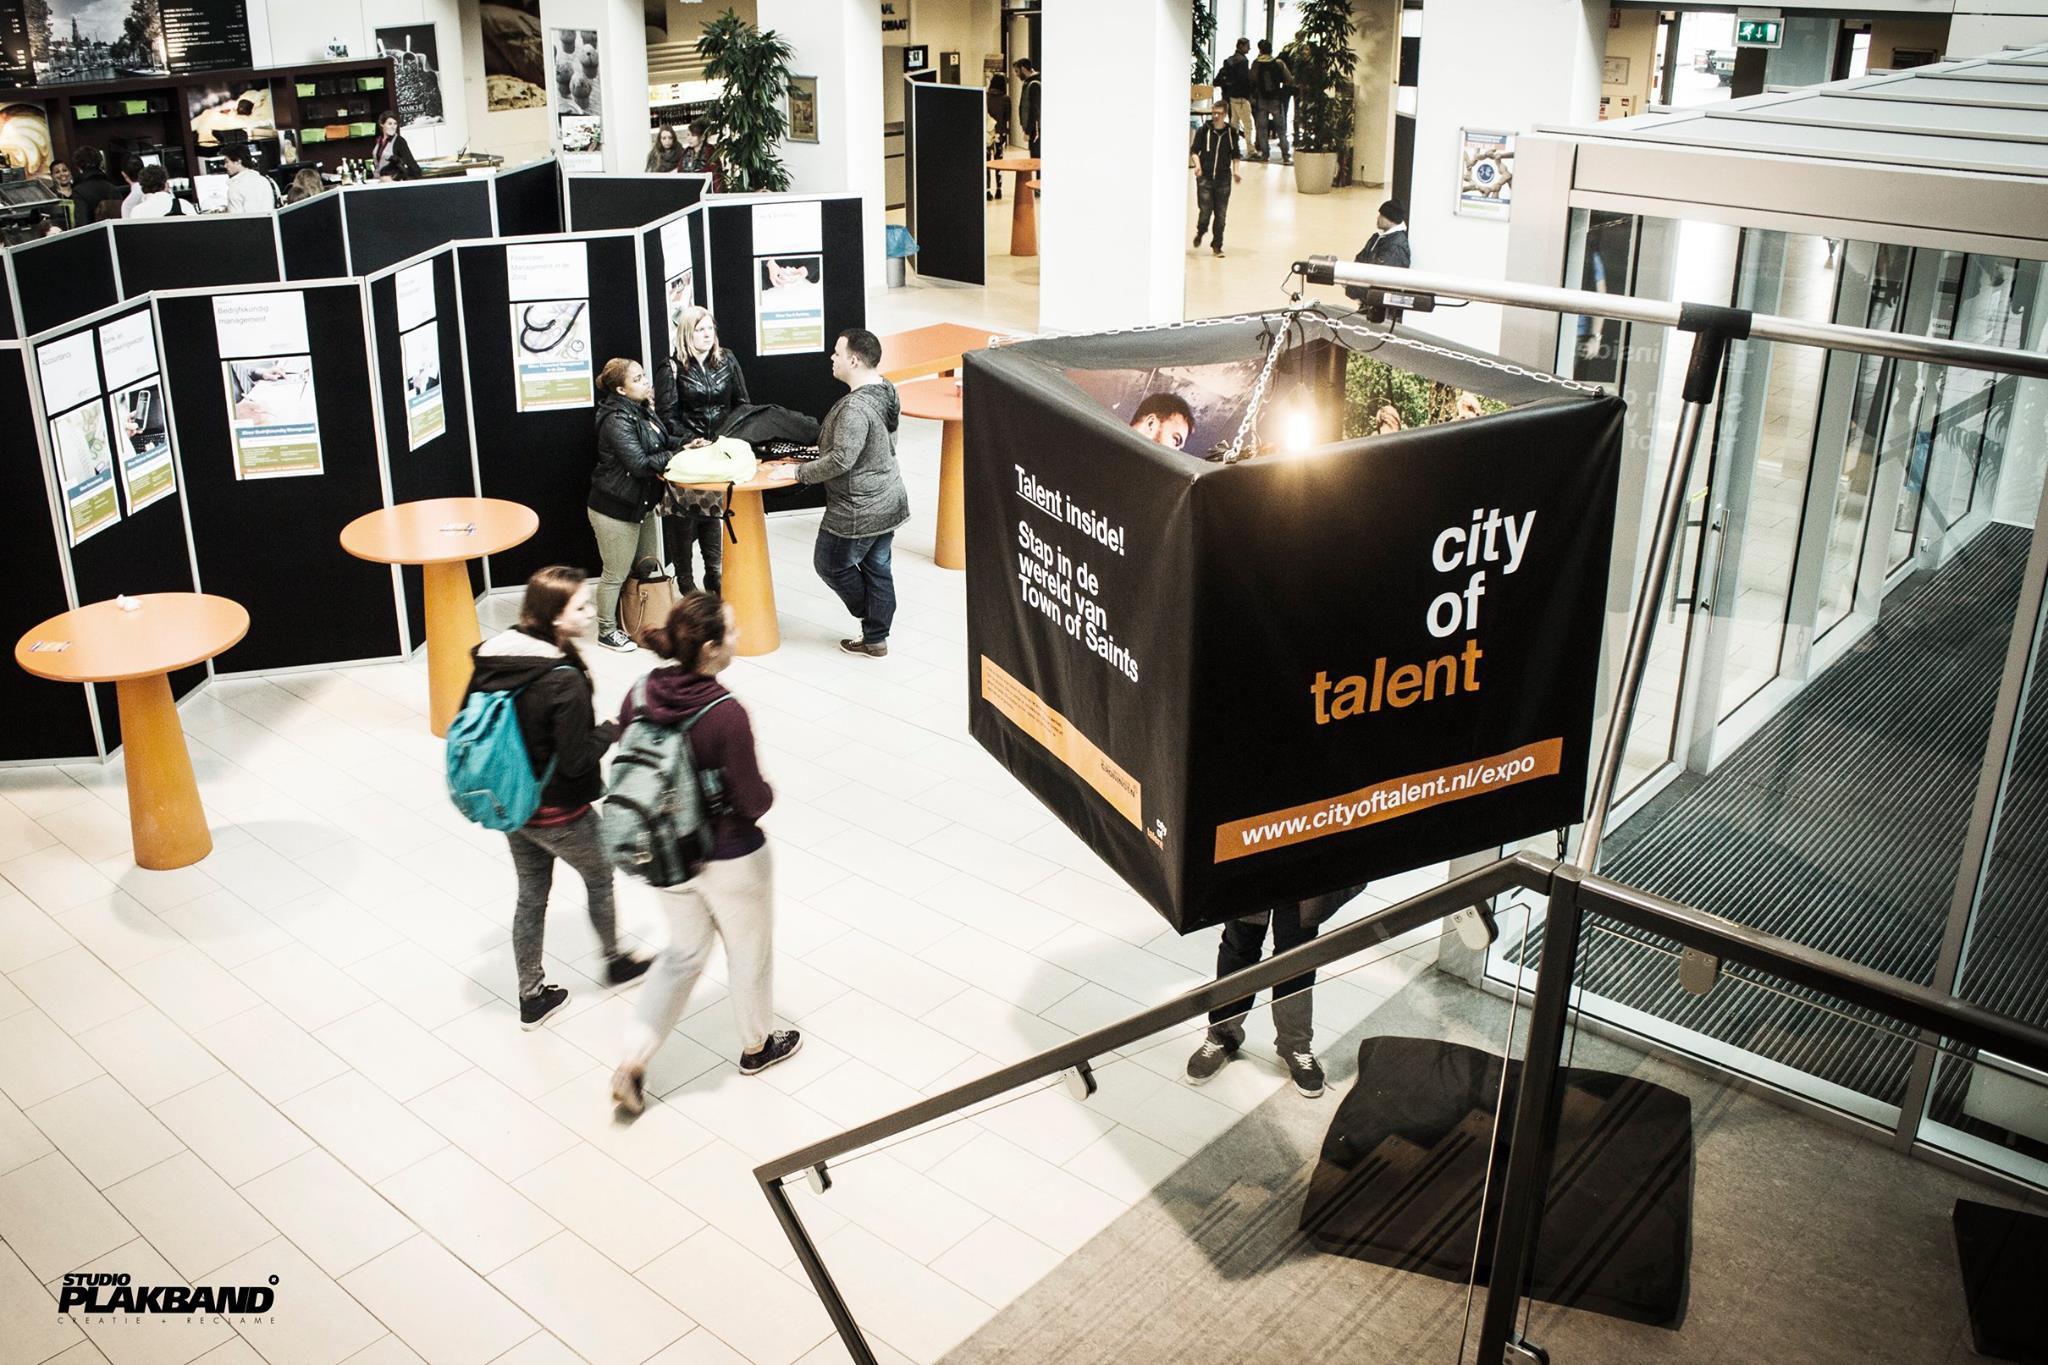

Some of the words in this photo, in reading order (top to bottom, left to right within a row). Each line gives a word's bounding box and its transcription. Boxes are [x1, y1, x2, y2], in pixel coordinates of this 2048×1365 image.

[218, 316, 267, 325] management
[1015, 463, 1063, 519] Talent
[1066, 495, 1125, 556] inside!
[1432, 507, 1537, 575] city
[1018, 520, 1053, 567] Stap
[1057, 546, 1072, 580] in
[1076, 562, 1099, 596] de
[1018, 553, 1071, 607] wereld
[1075, 592, 1107, 631] van
[1018, 573, 1061, 625] Town
[1065, 612, 1082, 640] of
[1085, 622, 1139, 683] Saints
[1426, 570, 1486, 638] of
[1310, 638, 1483, 725] talent
[1241, 753, 1536, 846] www.cityoftalent.nl/expo
